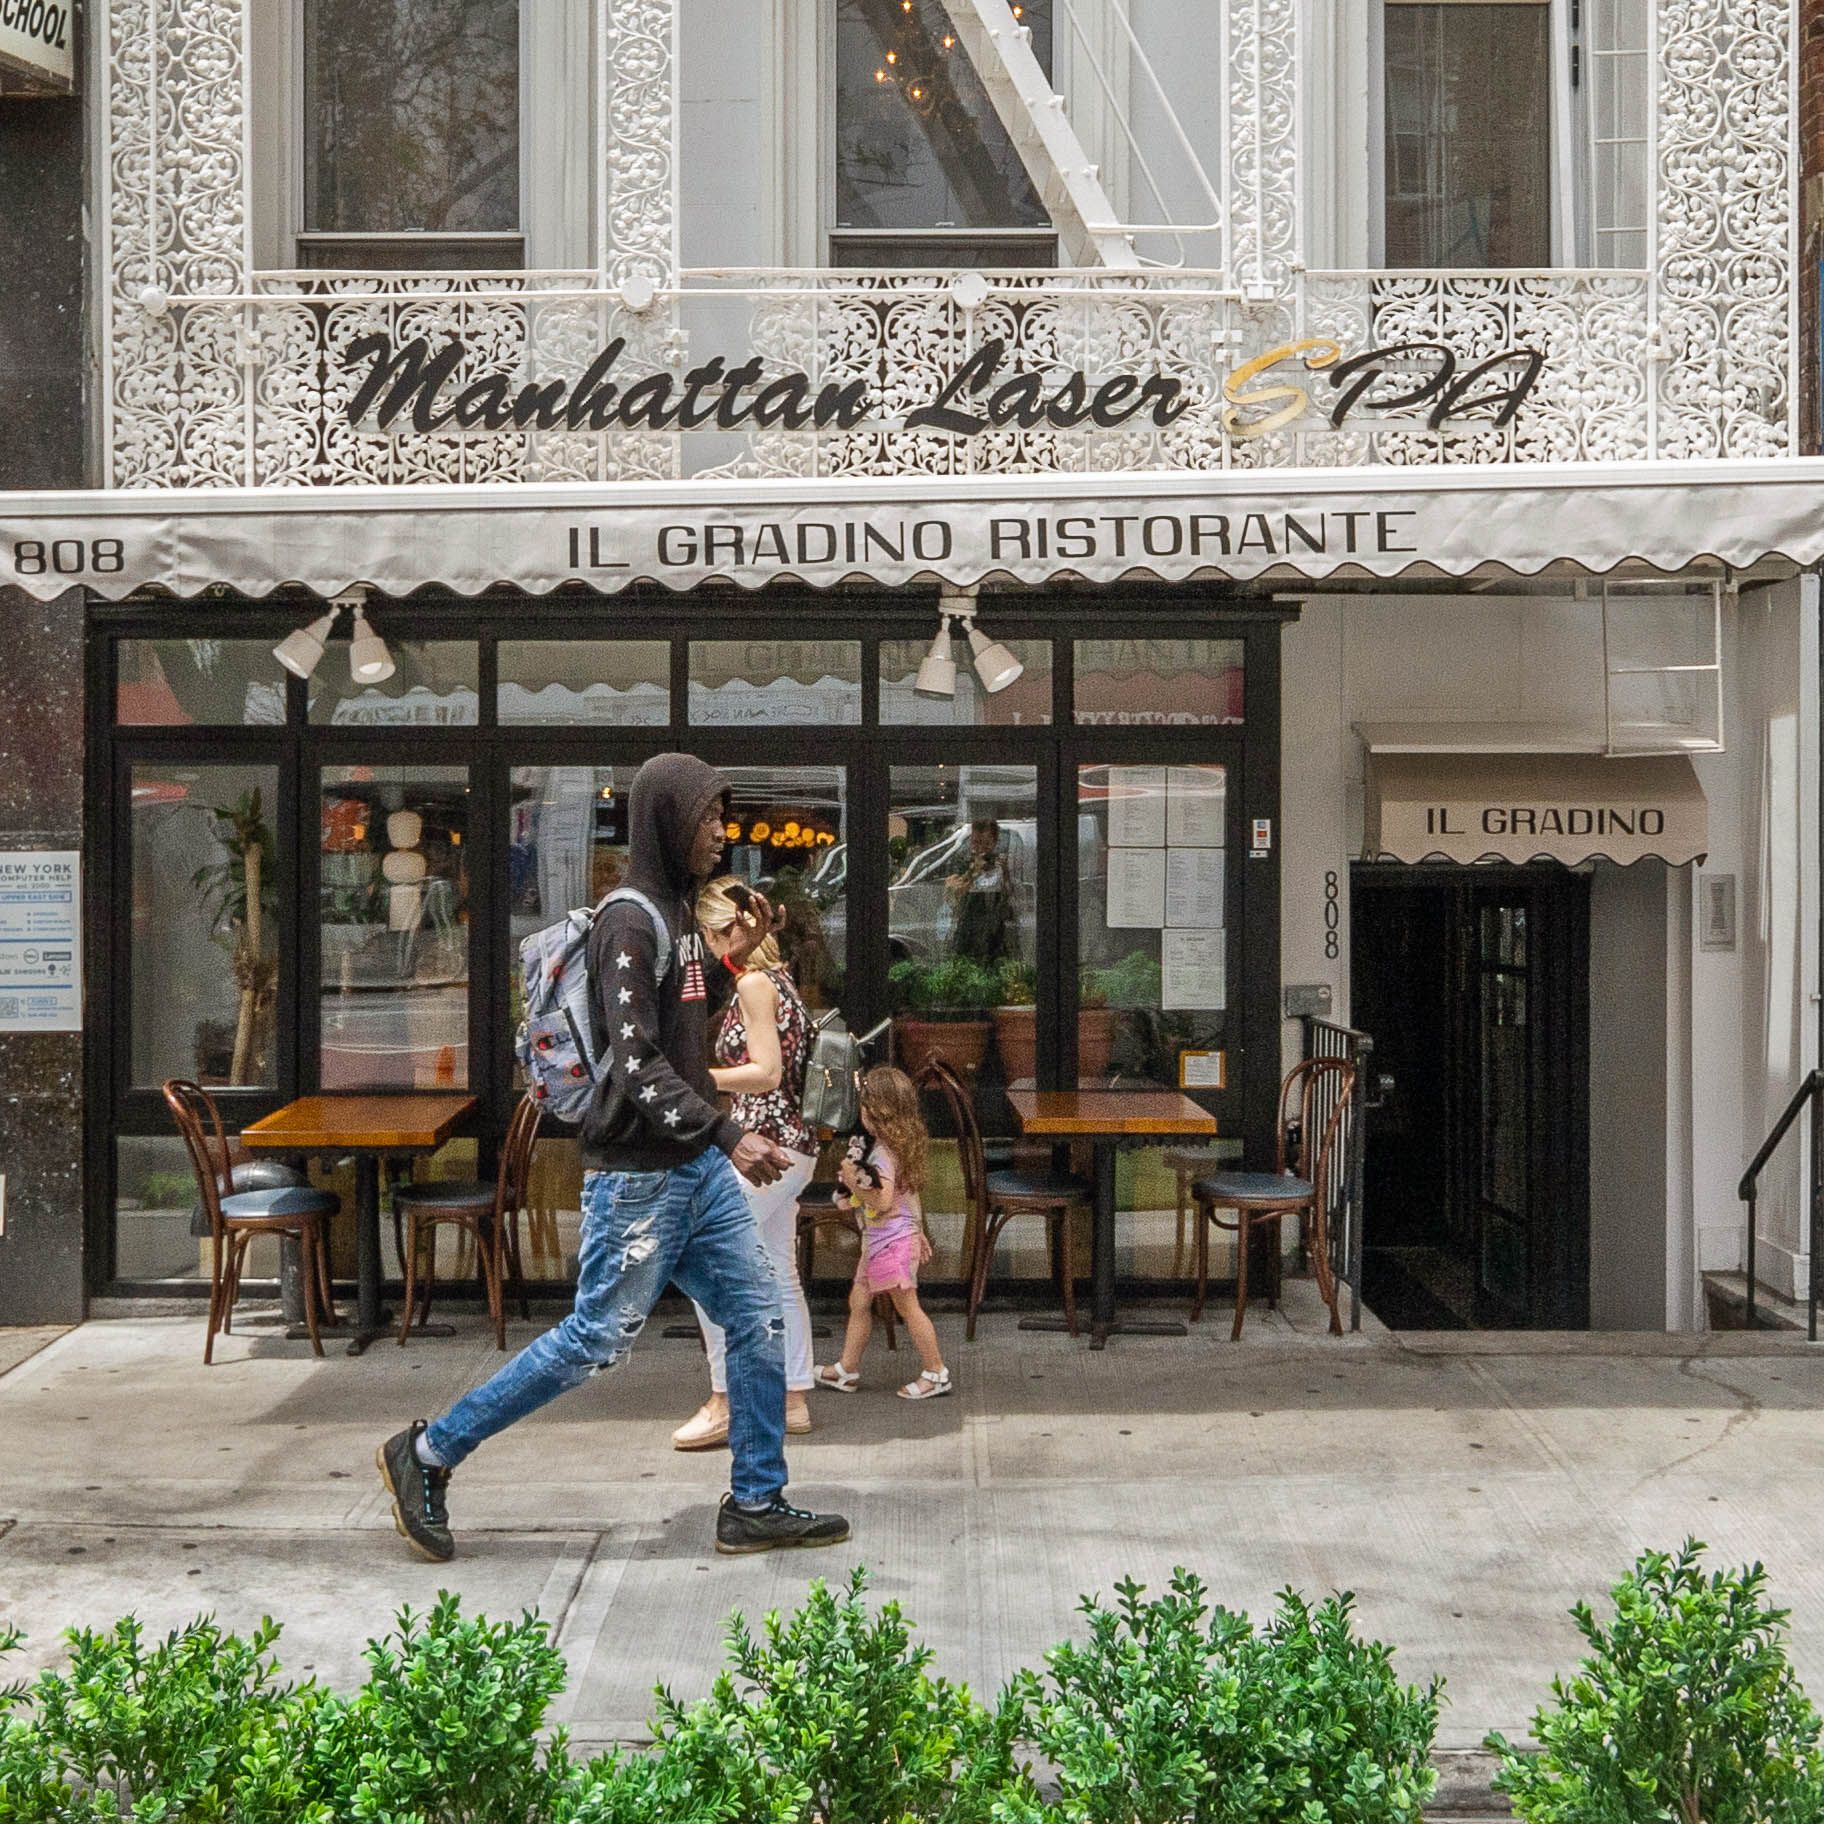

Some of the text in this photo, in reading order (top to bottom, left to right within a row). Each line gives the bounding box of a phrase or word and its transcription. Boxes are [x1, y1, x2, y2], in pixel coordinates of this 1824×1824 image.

[340, 332, 1545, 437] Manhattan Laser SPA
[13, 510, 1419, 577] 808 IL GRADINO RISTORANTE
[1426, 807, 1666, 837] IL GRADINO
[33, 864, 72, 874] YORK
